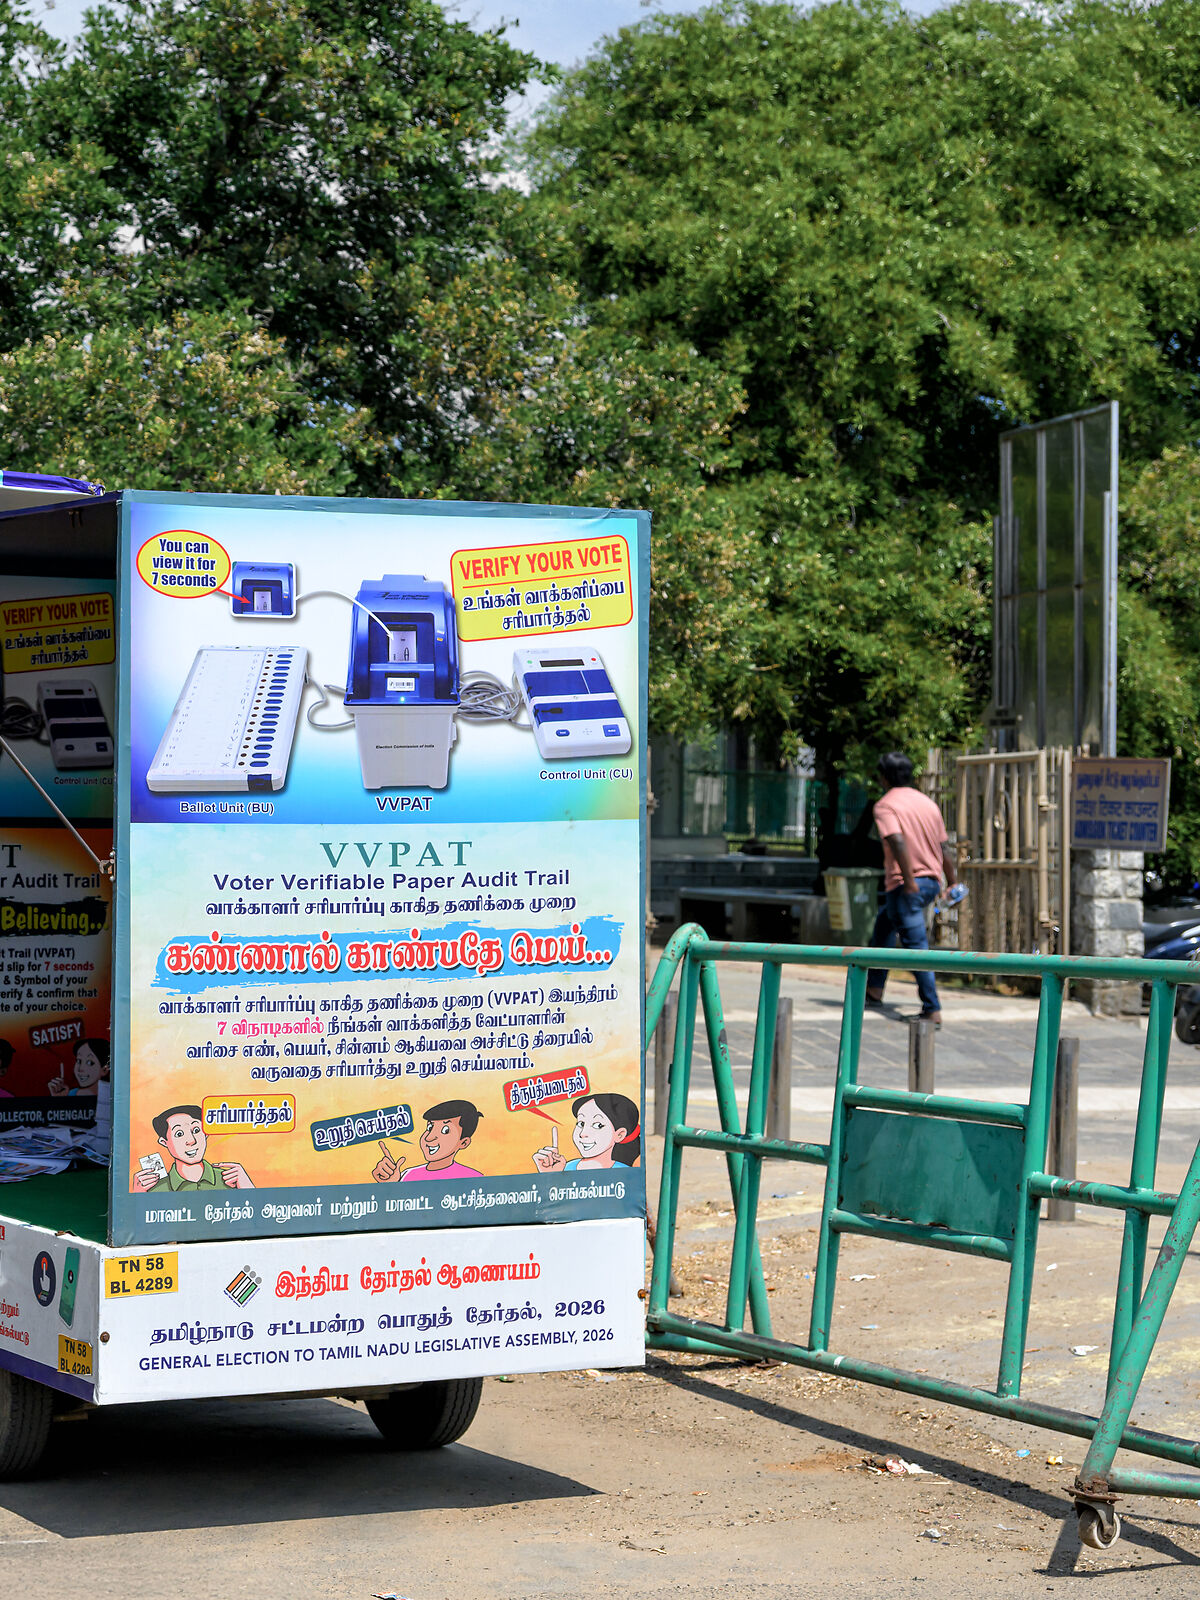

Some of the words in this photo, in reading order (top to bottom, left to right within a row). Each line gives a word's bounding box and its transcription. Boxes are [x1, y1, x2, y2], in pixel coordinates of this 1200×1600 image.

[159, 539, 182, 552] You
[185, 542, 209, 553] can
[152, 555, 183, 569] view
[185, 557, 195, 570] it
[197, 557, 216, 570] for
[459, 555, 521, 580] VERIFY
[526, 550, 574, 573] YOUR
[577, 543, 622, 567] VOTE
[152, 572, 159, 585] 7
[161, 574, 216, 587] seconds
[463, 587, 521, 611] உங்கள்
[525, 579, 624, 605] வாக்களிப்பை
[3, 606, 43, 625] VERIFY
[46, 603, 78, 620] YOUR
[80, 599, 109, 616] VOTE
[502, 602, 591, 630] சரிபார்த்தல்
[539, 769, 580, 780] Control
[584, 769, 606, 779] Unit
[609, 768, 633, 781] (CU)
[180, 803, 216, 813] Ballot
[220, 803, 244, 813] Unit
[248, 803, 274, 815] (BU)
[376, 797, 433, 811] VVPAT
[320, 841, 473, 868] VVPAT
[12, 873, 58, 888] Audit
[64, 873, 101, 888] Trail
[213, 874, 274, 890] Voter
[281, 873, 385, 890] Verifiable
[393, 873, 455, 892] Paper
[461, 871, 518, 888] Audit
[524, 869, 570, 887] Trail
[206, 897, 300, 915] வாக்காளர்
[304, 897, 385, 916] சரிபார்ப்பு
[390, 896, 440, 916] காகித
[443, 894, 525, 916] தணிக்கை
[529, 896, 576, 914] முறை
[1, 905, 109, 936] Believing...
[8, 948, 31, 958] Trail
[34, 948, 75, 960] (VVPAT)
[166, 931, 340, 974] கண்ணால்
[347, 928, 504, 977] காண்பதே
[510, 924, 611, 966] மெய்...
[7, 961, 25, 974] slip
[28, 962, 42, 972] for
[44, 961, 51, 971] 7
[53, 961, 95, 971] seconds
[14, 975, 51, 987] Symbol
[66, 976, 88, 987] your
[37, 988, 75, 998] confirm
[78, 988, 98, 998] that
[158, 995, 241, 1014] வாக்காளர்
[245, 994, 315, 1014] சரிபார்ப்பு
[320, 994, 364, 1013] காகித
[367, 991, 438, 1013] தணிக்கை
[442, 993, 483, 1011] முறை
[487, 987, 545, 1008] (VVPAT)
[549, 983, 618, 1006] இயந்திரம்
[26, 1003, 48, 1014] your
[51, 1001, 87, 1012] choice.
[32, 1022, 82, 1046] SATISFY
[217, 1021, 228, 1035] 7
[231, 1016, 325, 1038] விநாடிகளில்
[327, 1015, 383, 1037] நீங்கள்
[386, 1011, 471, 1032] வாக்களித்த
[475, 1008, 566, 1028] வேட்பாளரின்
[186, 1041, 239, 1059] வரிசை
[242, 1039, 280, 1059] எண்,
[284, 1038, 331, 1058] பெயர்,
[335, 1036, 390, 1057] சின்னம்
[394, 1035, 467, 1055] ஆகியவை
[470, 1032, 529, 1051] அச்சிட்டு
[532, 1027, 594, 1050] திரையில்
[251, 1065, 322, 1082] வருவதை
[325, 1058, 402, 1079] சரிபார்த்து
[406, 1056, 447, 1078] உறுதி
[450, 1052, 535, 1073] செய்யலாம்.
[510, 1069, 587, 1109] திருப்தியடைதல்
[47, 1109, 95, 1121] CHENGALP
[205, 1101, 293, 1128] சரிபார்த்தல்
[315, 1119, 355, 1148] உறுதி
[357, 1107, 410, 1138] செய்தல்
[145, 1206, 197, 1223] மாவட்ட
[205, 1200, 254, 1224] தேர்தல்
[261, 1197, 323, 1223] அலுவலர்
[330, 1195, 378, 1220] மற்றும்
[386, 1195, 434, 1212] மாவட்ட
[441, 1184, 542, 1211] ஆட்சித்தலைவர்,
[549, 1180, 625, 1202] செங்கல்பட்டு
[118, 1260, 140, 1274] TN
[146, 1257, 164, 1272] 58
[275, 1265, 349, 1301] இந்திய
[360, 1257, 432, 1295] தேர்தல்
[437, 1252, 541, 1289] ஆணையம்
[110, 1280, 131, 1294] BL
[135, 1276, 173, 1292] 4289
[150, 1320, 254, 1346] தமிழ்நாடு
[267, 1313, 365, 1337] சட்டமன்ற
[377, 1306, 453, 1332] பொதுத்
[466, 1300, 542, 1326] தேர்தல்,
[554, 1299, 605, 1318] 2026
[65, 1339, 76, 1354] TN
[77, 1343, 87, 1358] 58
[139, 1354, 211, 1371] GENERAL
[216, 1350, 289, 1367] ELECTION
[294, 1348, 314, 1363] TO
[319, 1345, 362, 1361] TAMIL
[367, 1342, 410, 1358] NADU
[414, 1336, 501, 1354] LEGISLATIVE
[505, 1330, 578, 1348] ASSEMBLY,
[582, 1328, 614, 1343] 2026
[60, 1357, 70, 1372] BL
